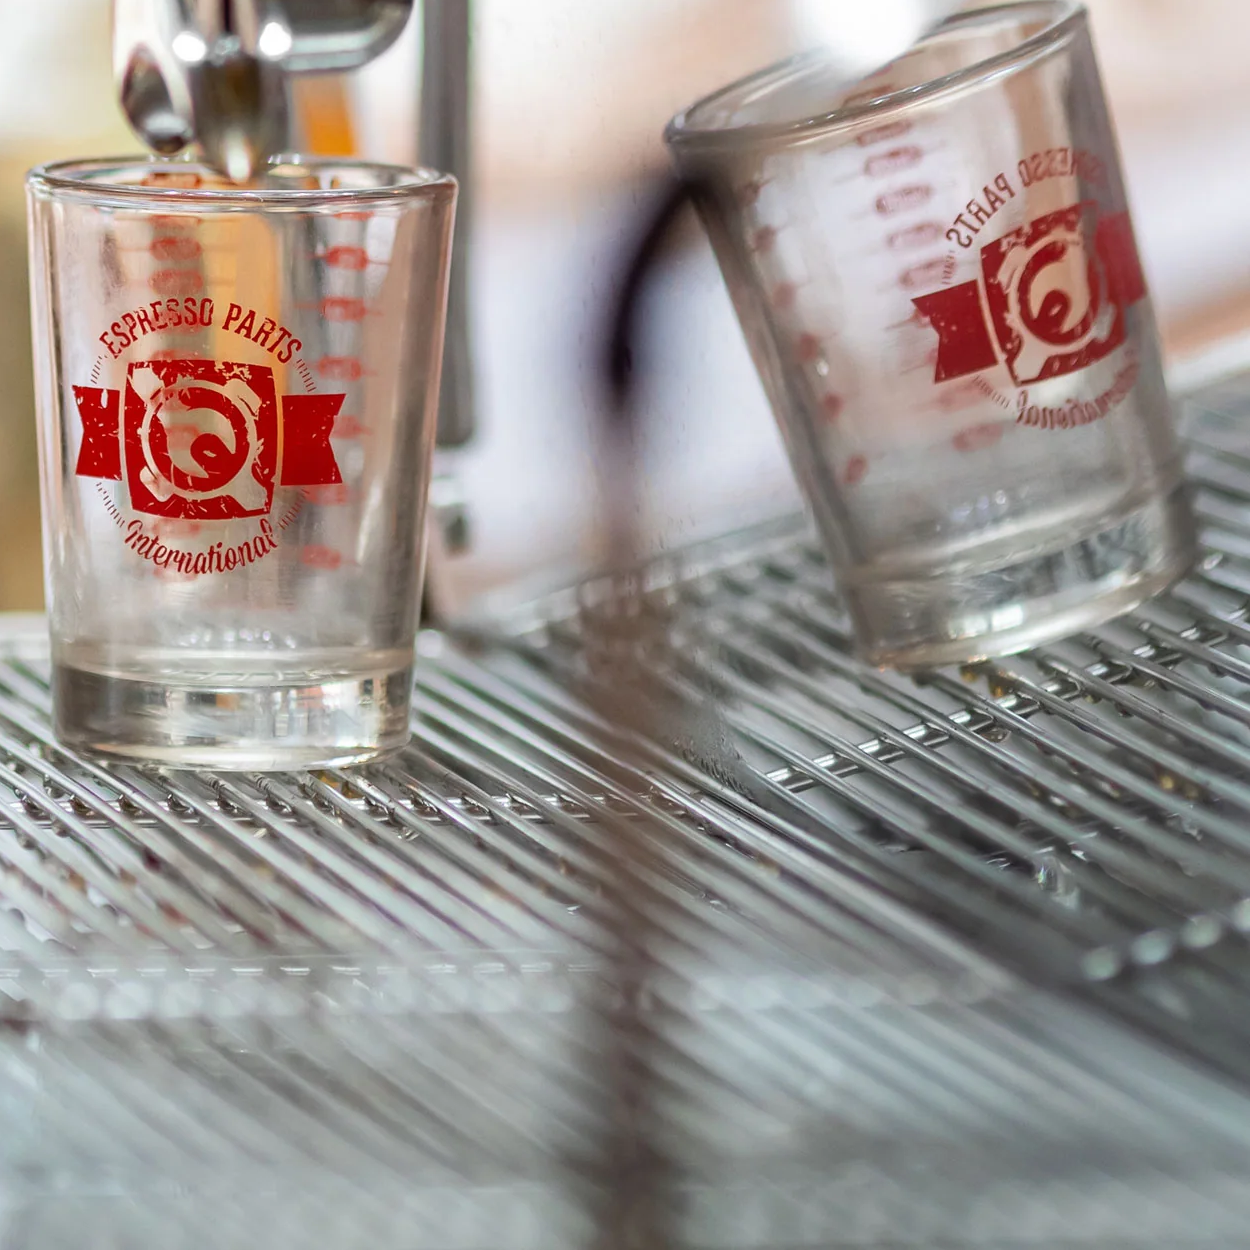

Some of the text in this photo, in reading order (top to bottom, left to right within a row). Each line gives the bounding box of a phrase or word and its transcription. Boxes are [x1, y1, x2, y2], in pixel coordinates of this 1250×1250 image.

[99, 297, 303, 363] ESPRESSO PARTS
[124, 518, 278, 574] International
